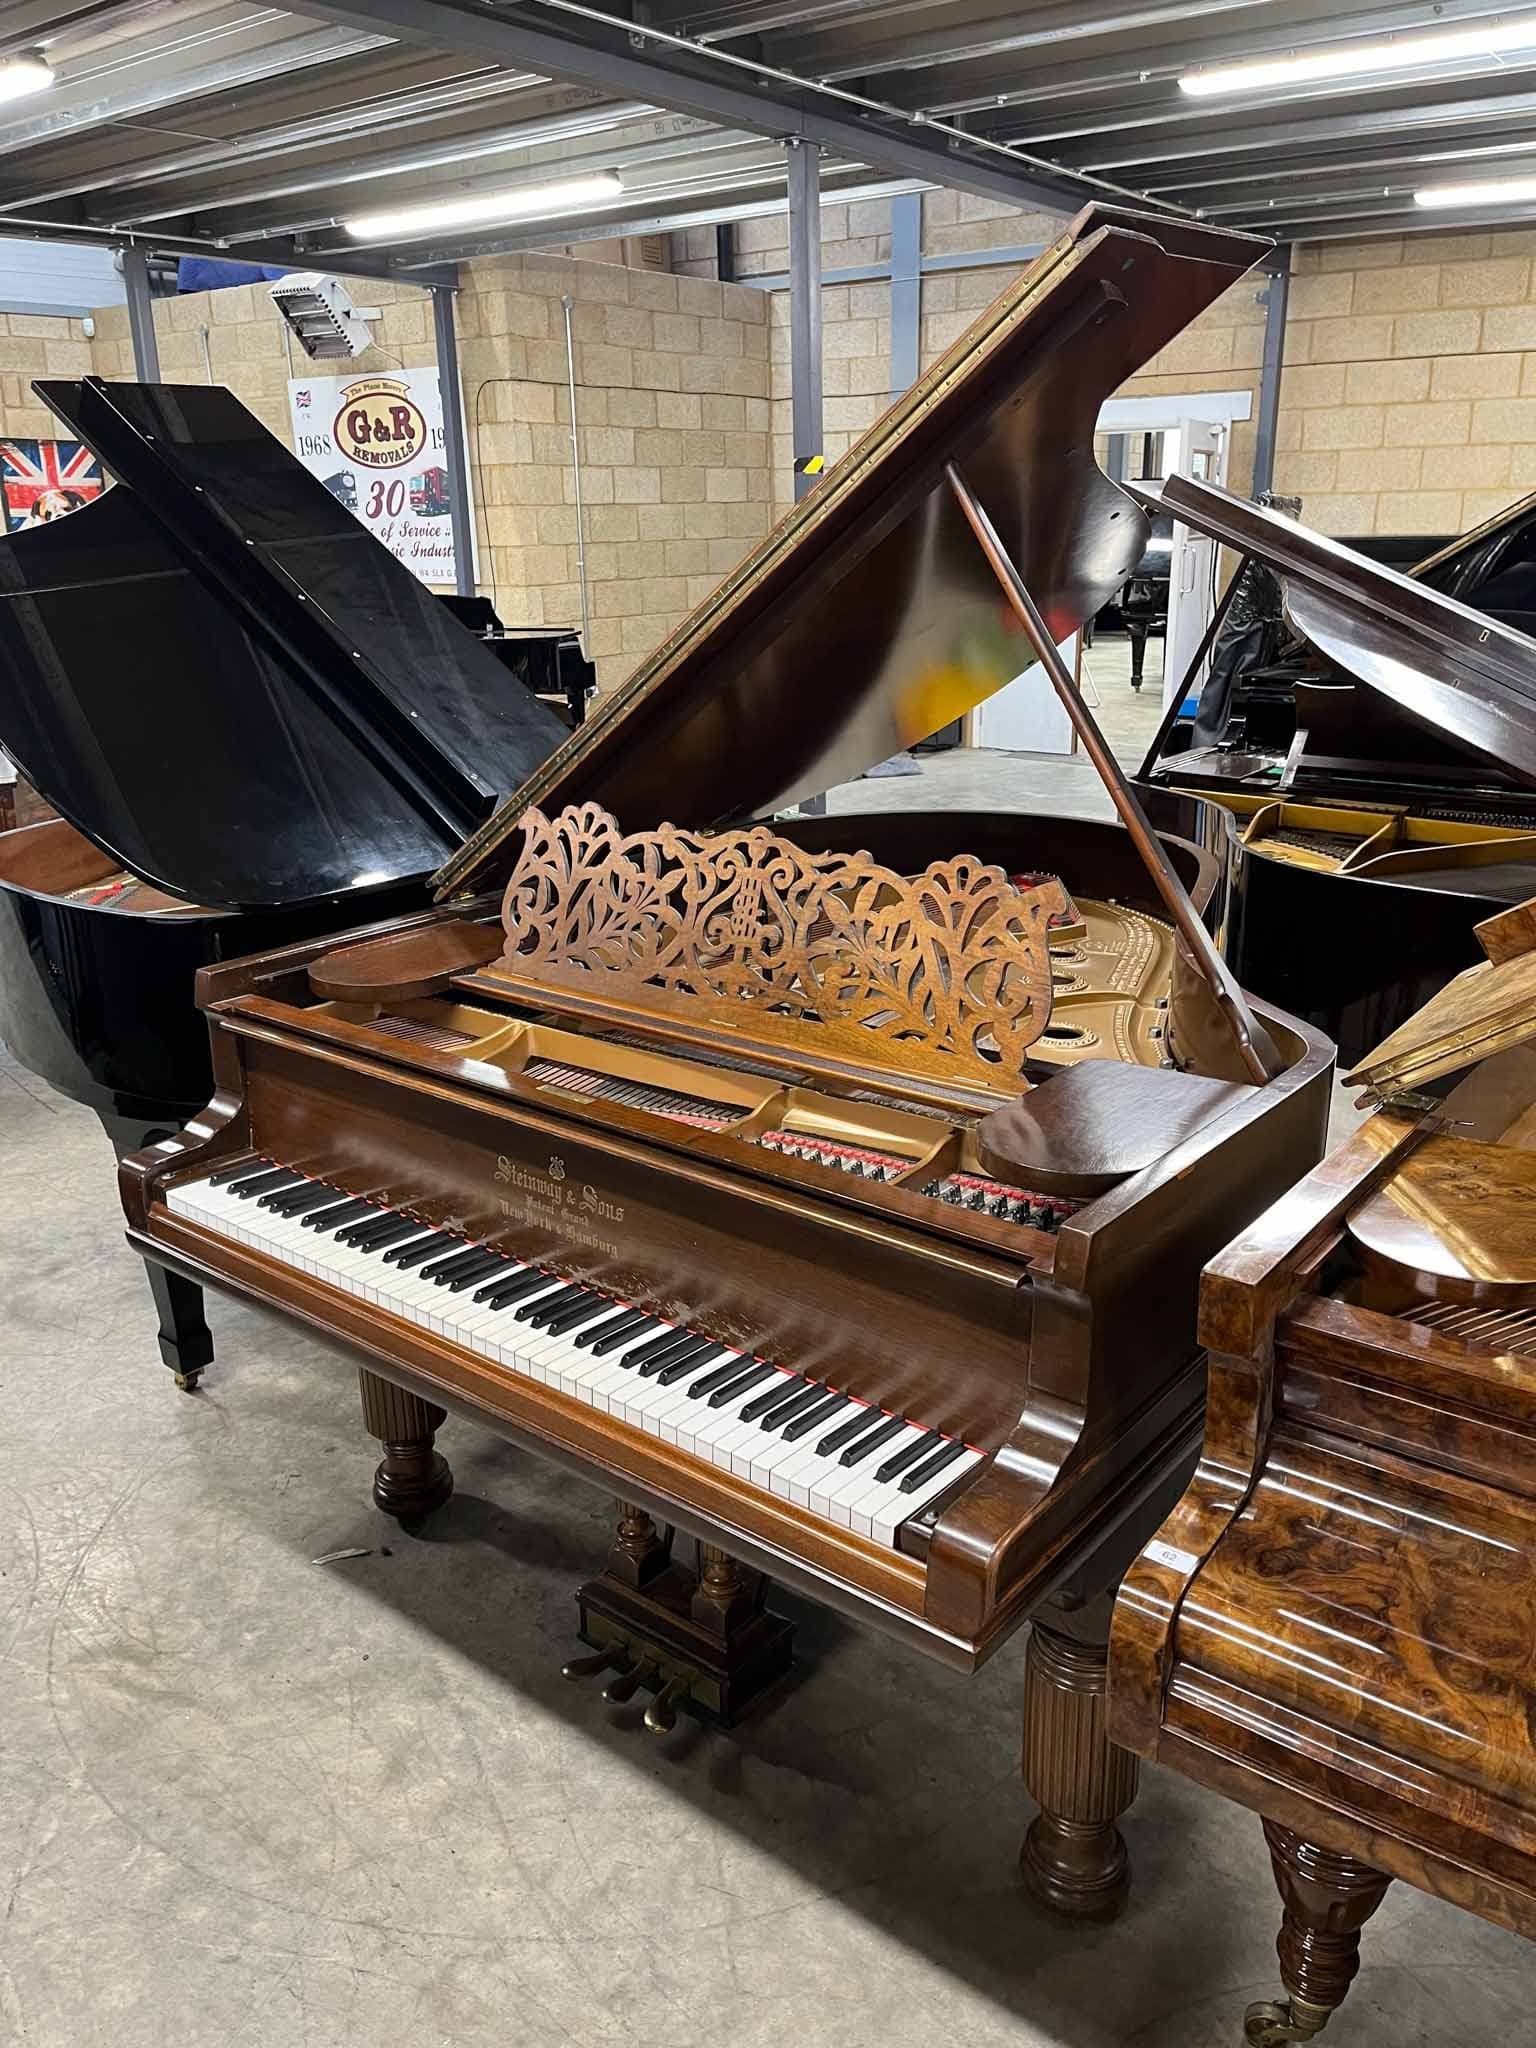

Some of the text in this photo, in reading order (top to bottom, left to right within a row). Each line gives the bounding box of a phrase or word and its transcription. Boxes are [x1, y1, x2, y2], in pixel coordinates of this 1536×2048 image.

[347, 405, 416, 444] G&R
[298, 434, 332, 456] 1968
[431, 426, 446, 449] 19
[352, 441, 415, 465] REMOVALS
[365, 480, 405, 518] 30
[380, 521, 395, 542] of
[399, 520, 441, 537] Service
[411, 541, 455, 557] Indust
[494, 1155, 625, 1222] Steinway & Sons
[1161, 1551, 1177, 1562] 62
